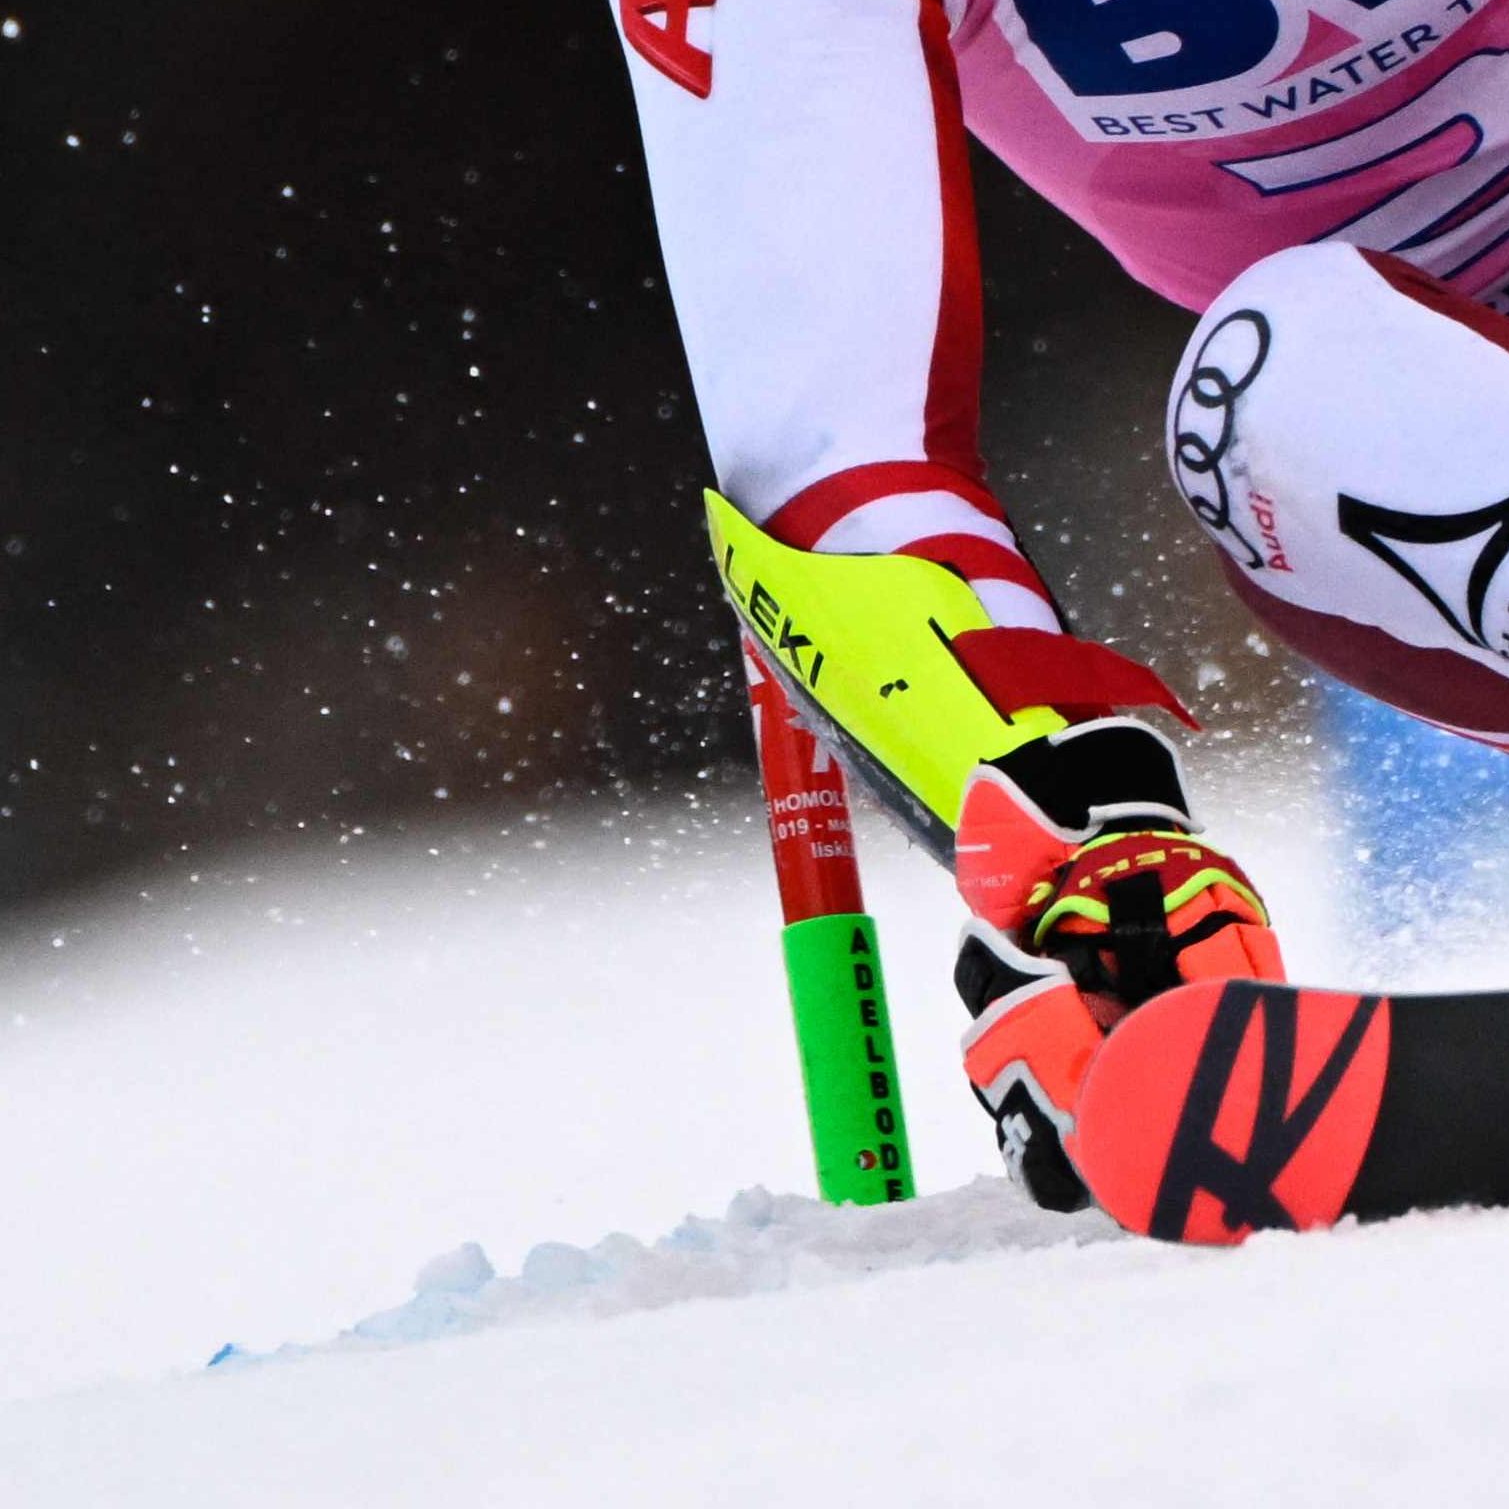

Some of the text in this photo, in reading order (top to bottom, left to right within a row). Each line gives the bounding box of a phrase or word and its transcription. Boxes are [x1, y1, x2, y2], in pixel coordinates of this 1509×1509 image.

[1094, 105, 1225, 137] BEST
[1241, 23, 1440, 118] WATER
[724, 543, 825, 689] LEKI
[773, 817, 809, 843] 019
